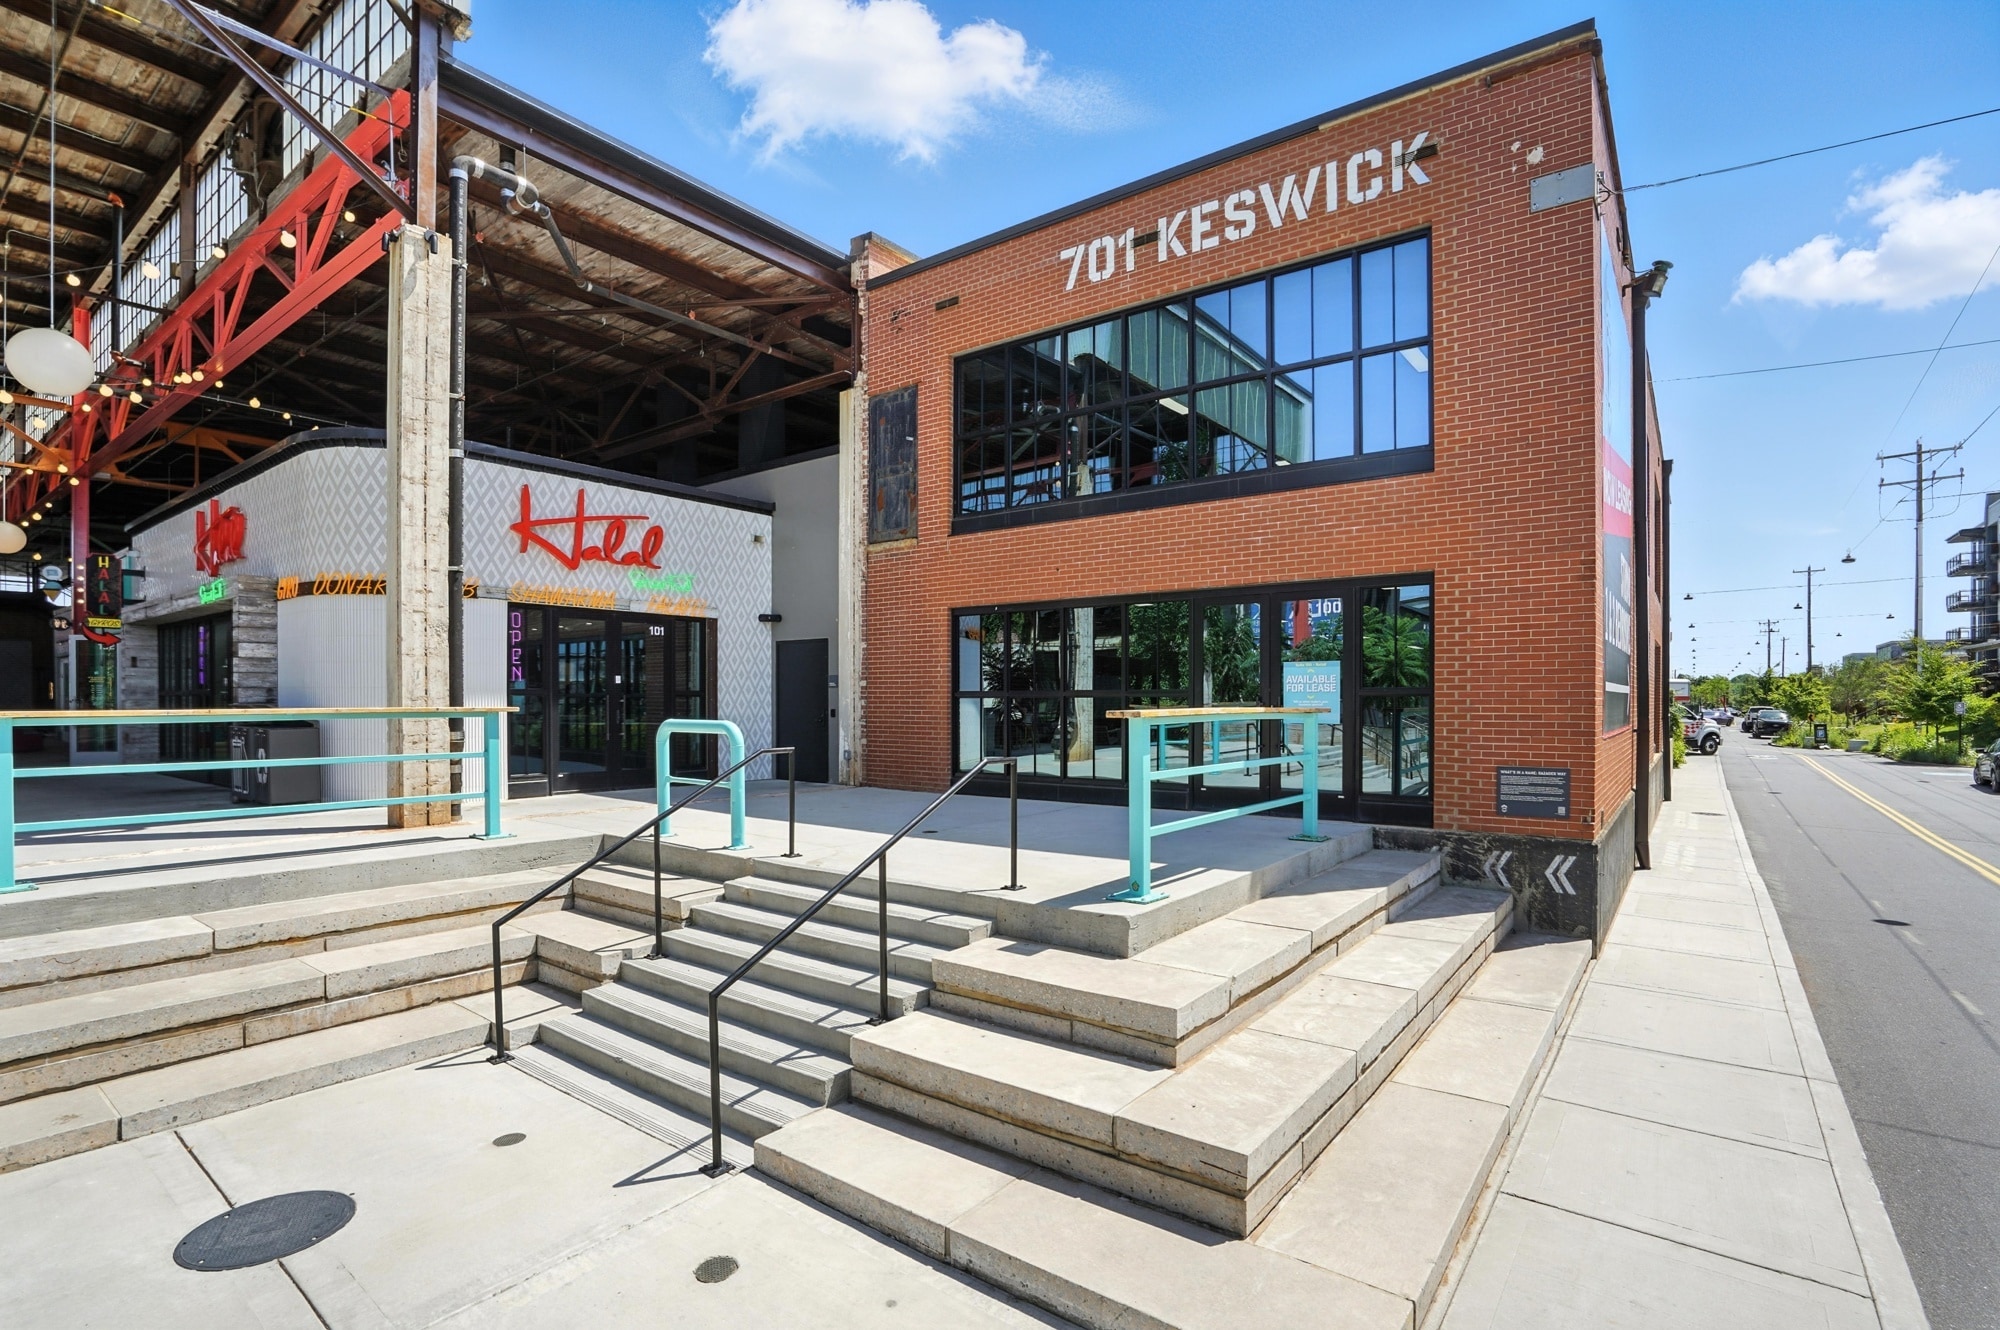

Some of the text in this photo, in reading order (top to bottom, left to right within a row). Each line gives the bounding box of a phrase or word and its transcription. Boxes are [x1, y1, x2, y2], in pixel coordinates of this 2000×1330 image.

[1060, 131, 1431, 290] 701 KESWICK
[509, 484, 664, 571] Halal
[97, 556, 110, 616] HALAL
[276, 576, 299, 600] GYRO
[91, 619, 120, 627] GYROS
[649, 626, 665, 636] 101
[511, 612, 522, 682] OPEN
[1286, 675, 1337, 684] AVAILABLE
[1286, 684, 1337, 692] FOR LEASE
